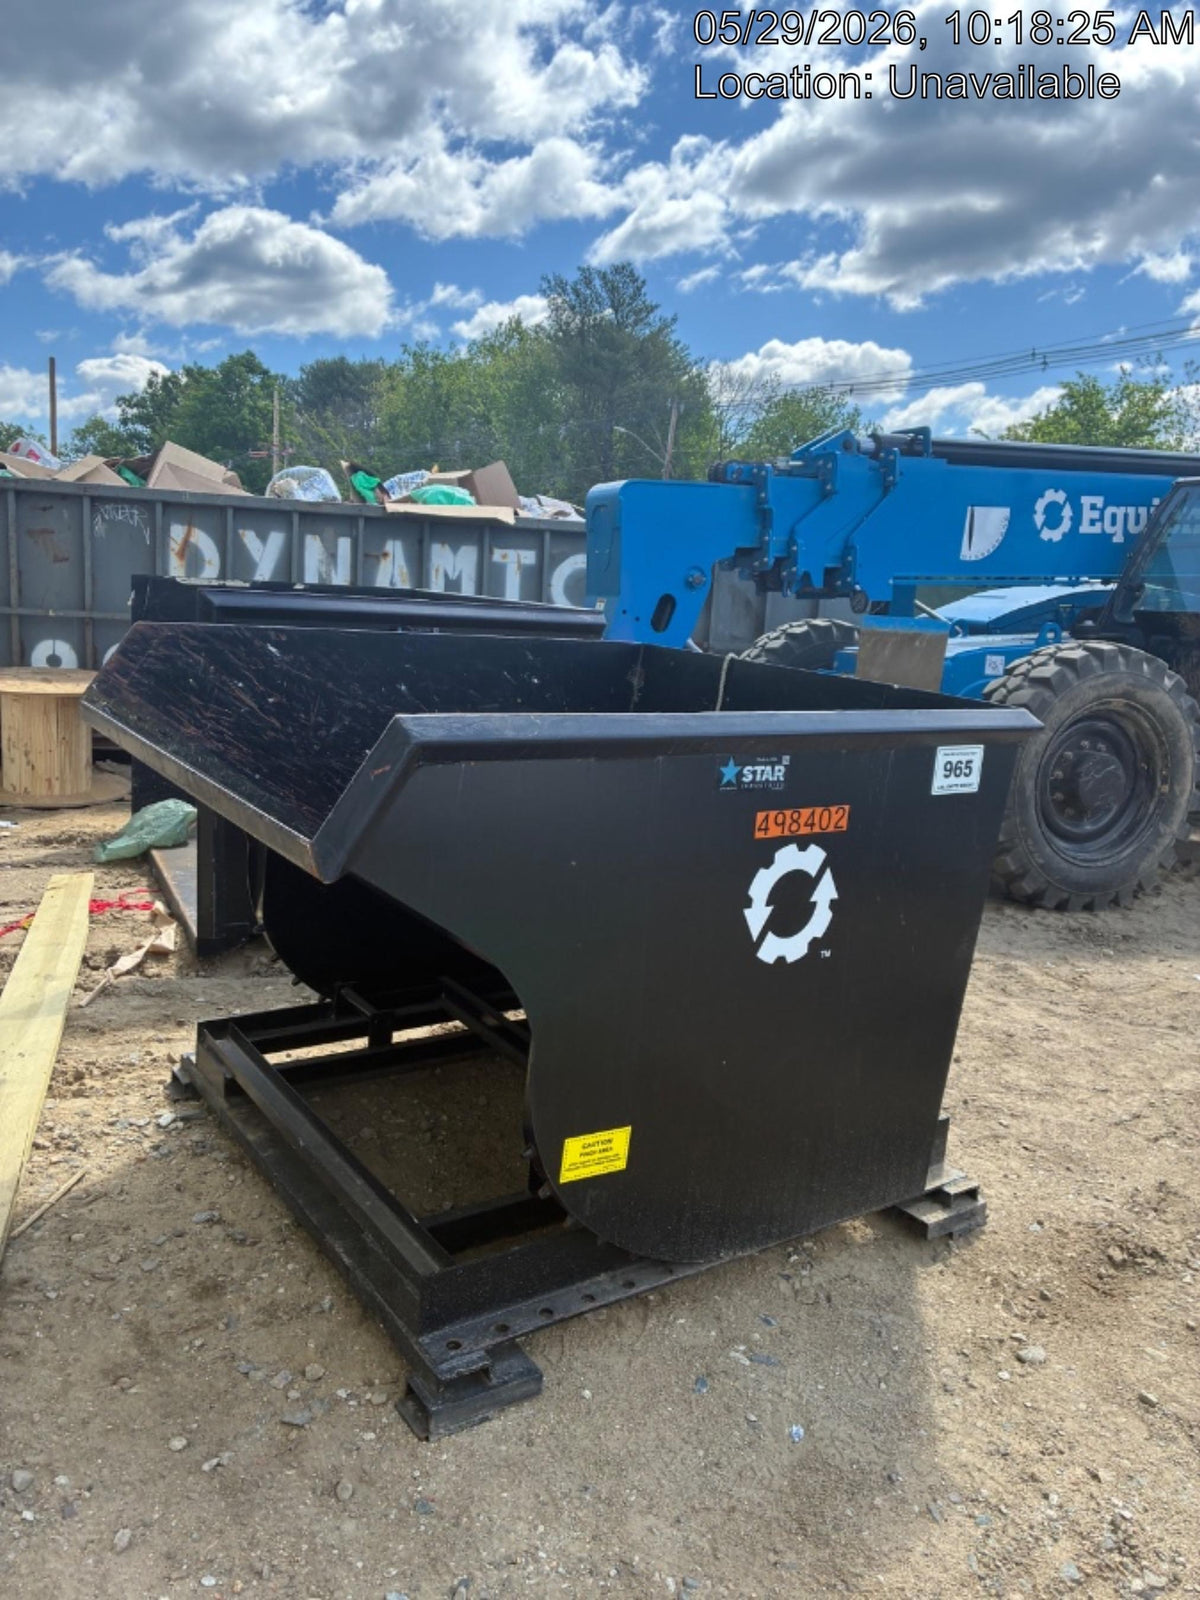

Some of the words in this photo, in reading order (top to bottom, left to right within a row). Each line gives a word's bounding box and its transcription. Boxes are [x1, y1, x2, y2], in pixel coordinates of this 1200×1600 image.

[1079, 495, 1160, 543] Equ
[741, 765, 785, 782] STAR
[943, 760, 973, 778] 965
[757, 806, 846, 836] 498402
[582, 1138, 614, 1149] CAUTION
